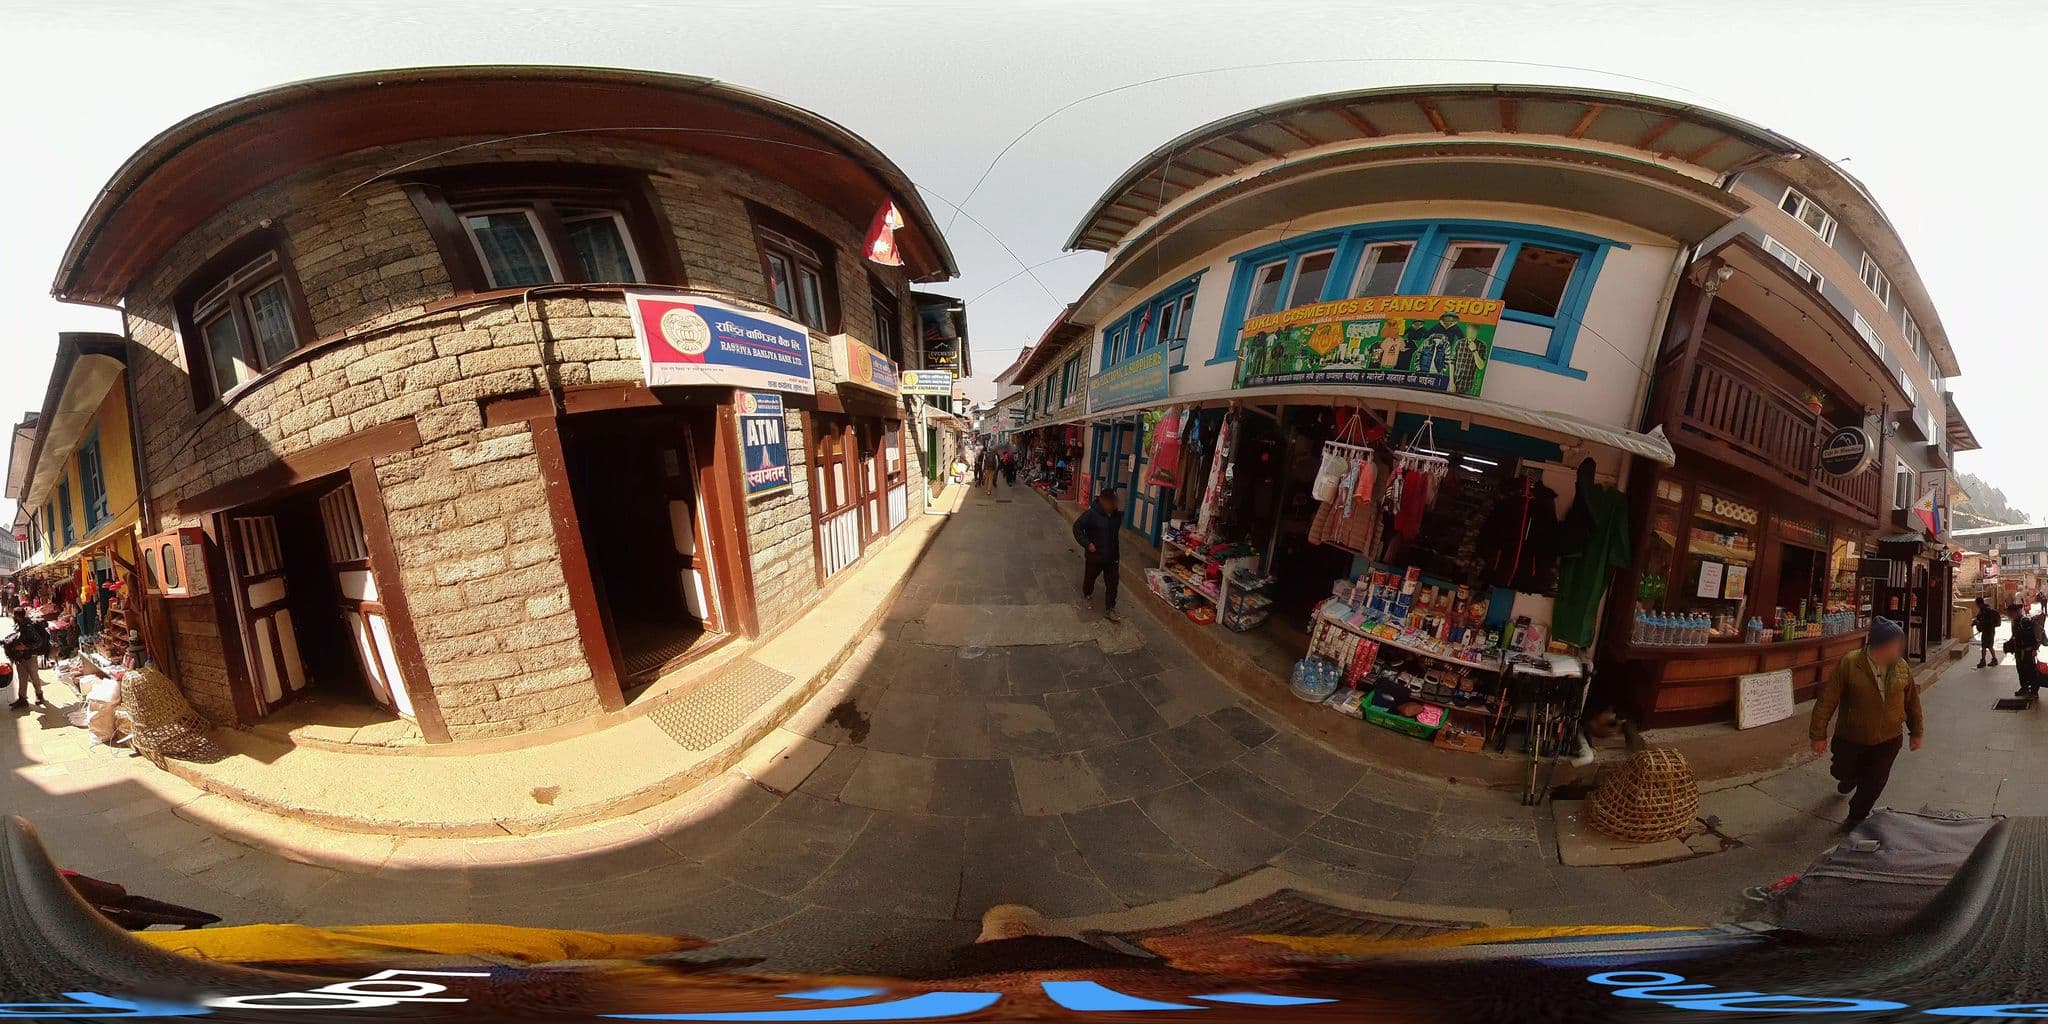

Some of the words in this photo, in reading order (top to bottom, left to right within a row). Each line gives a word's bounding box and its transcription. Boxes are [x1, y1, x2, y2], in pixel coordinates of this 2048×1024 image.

[1246, 316, 1279, 331] LUKLA
[1283, 300, 1358, 324] COSMETICS
[1363, 300, 1375, 313] &
[1380, 298, 1440, 312] FANCY
[1443, 299, 1498, 317] SHOP
[778, 353, 792, 364] BANK
[933, 356, 953, 364] YAK
[747, 419, 780, 446] ATM
[746, 466, 788, 487] स्वागतम्
